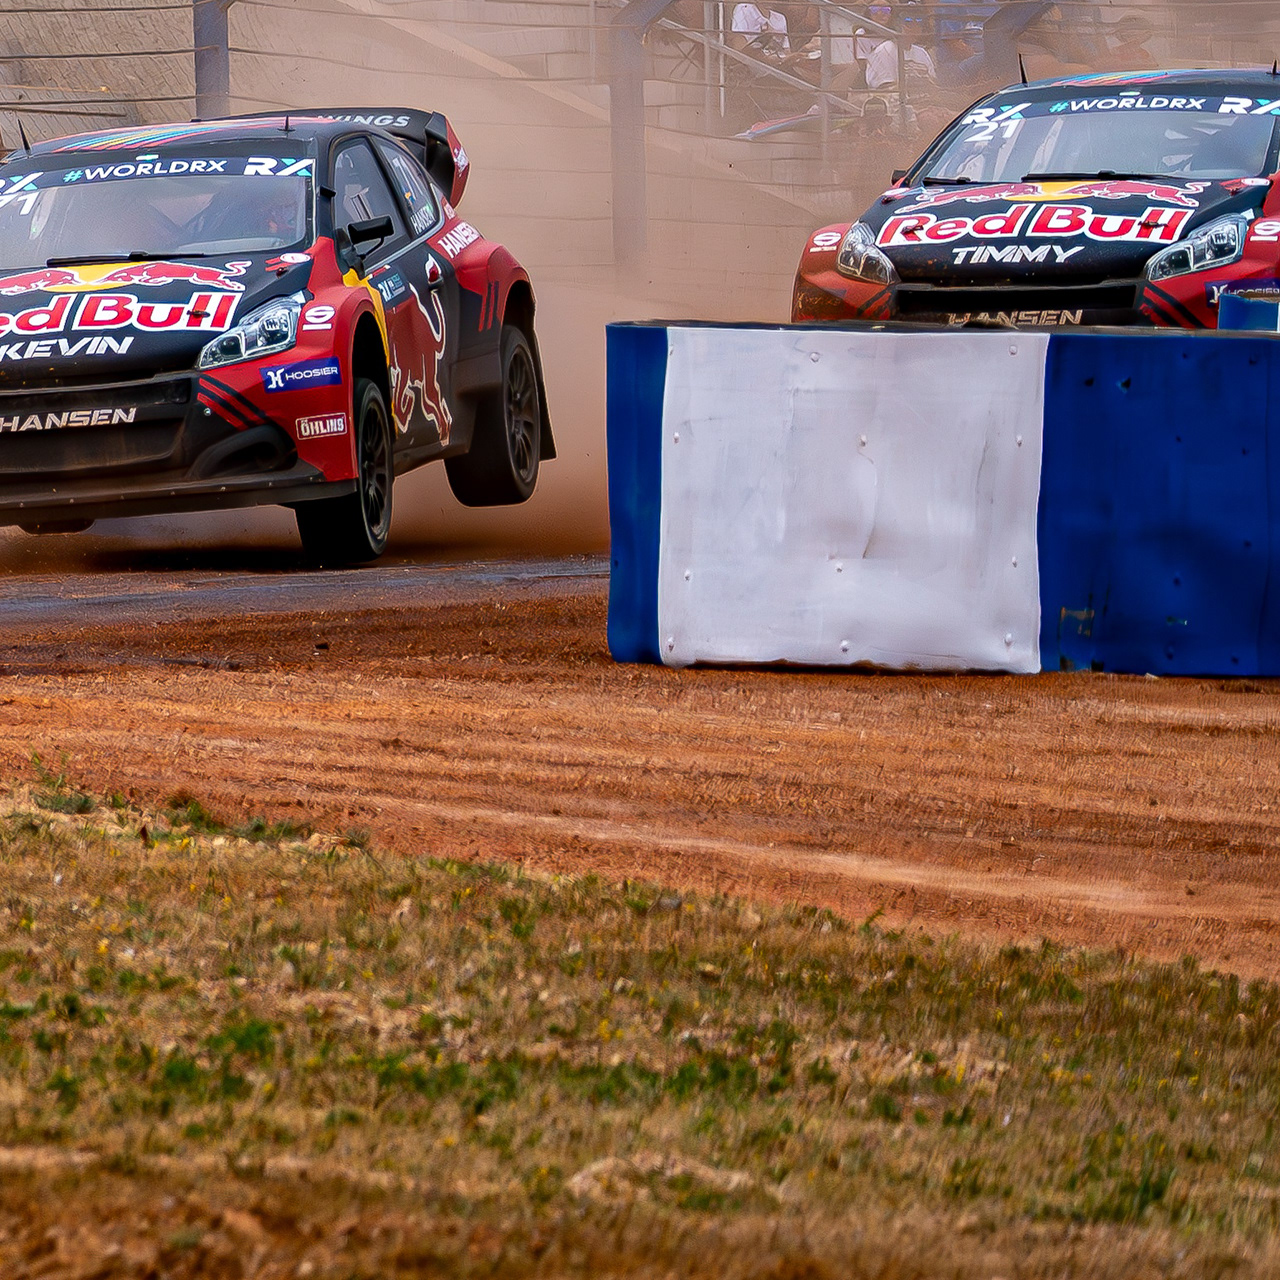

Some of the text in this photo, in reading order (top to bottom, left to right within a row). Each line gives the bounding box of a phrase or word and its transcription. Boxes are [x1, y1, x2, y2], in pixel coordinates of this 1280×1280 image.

[962, 102, 1032, 124] RX
[1049, 96, 1207, 114] #WORLDRX
[1217, 96, 1280, 116] RX
[964, 119, 1020, 143] 21
[63, 159, 228, 183] #WORLDRX
[243, 156, 315, 177] RX
[876, 204, 1191, 246] Red Bull
[951, 244, 1086, 264] TIMMY
[75, 292, 239, 331] Bull
[285, 366, 338, 381] HOOSIER
